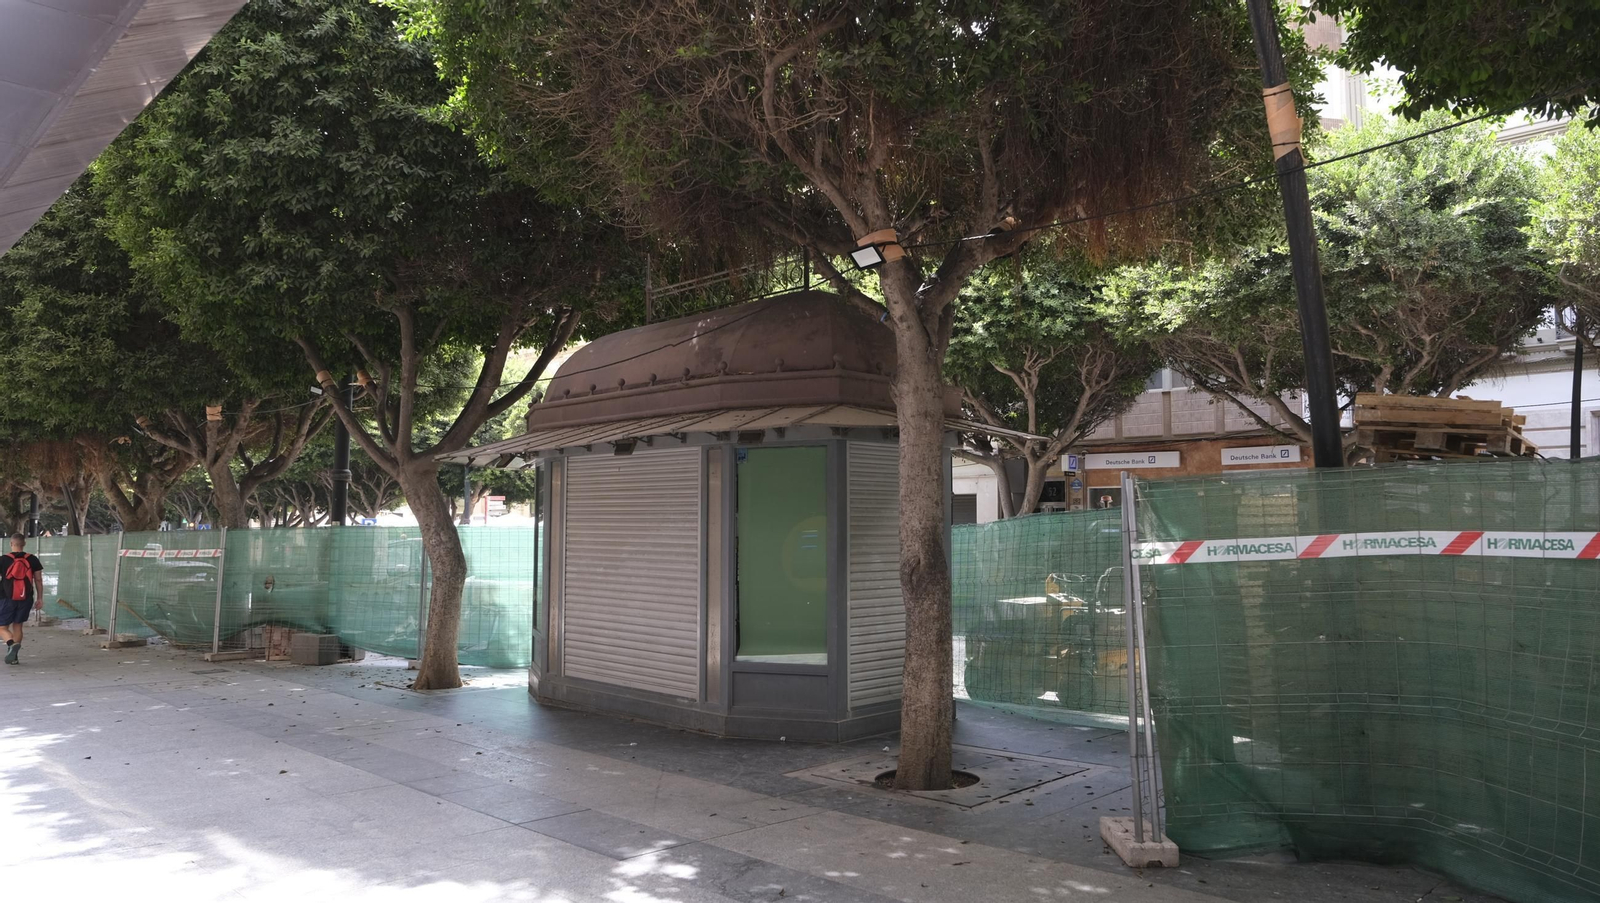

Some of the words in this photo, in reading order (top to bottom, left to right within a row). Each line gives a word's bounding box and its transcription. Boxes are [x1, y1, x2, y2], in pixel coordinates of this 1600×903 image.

[1207, 542, 1295, 557] HORMACESA
[1342, 536, 1437, 550] HORMACESA
[1487, 537, 1575, 551] HORMACESA
